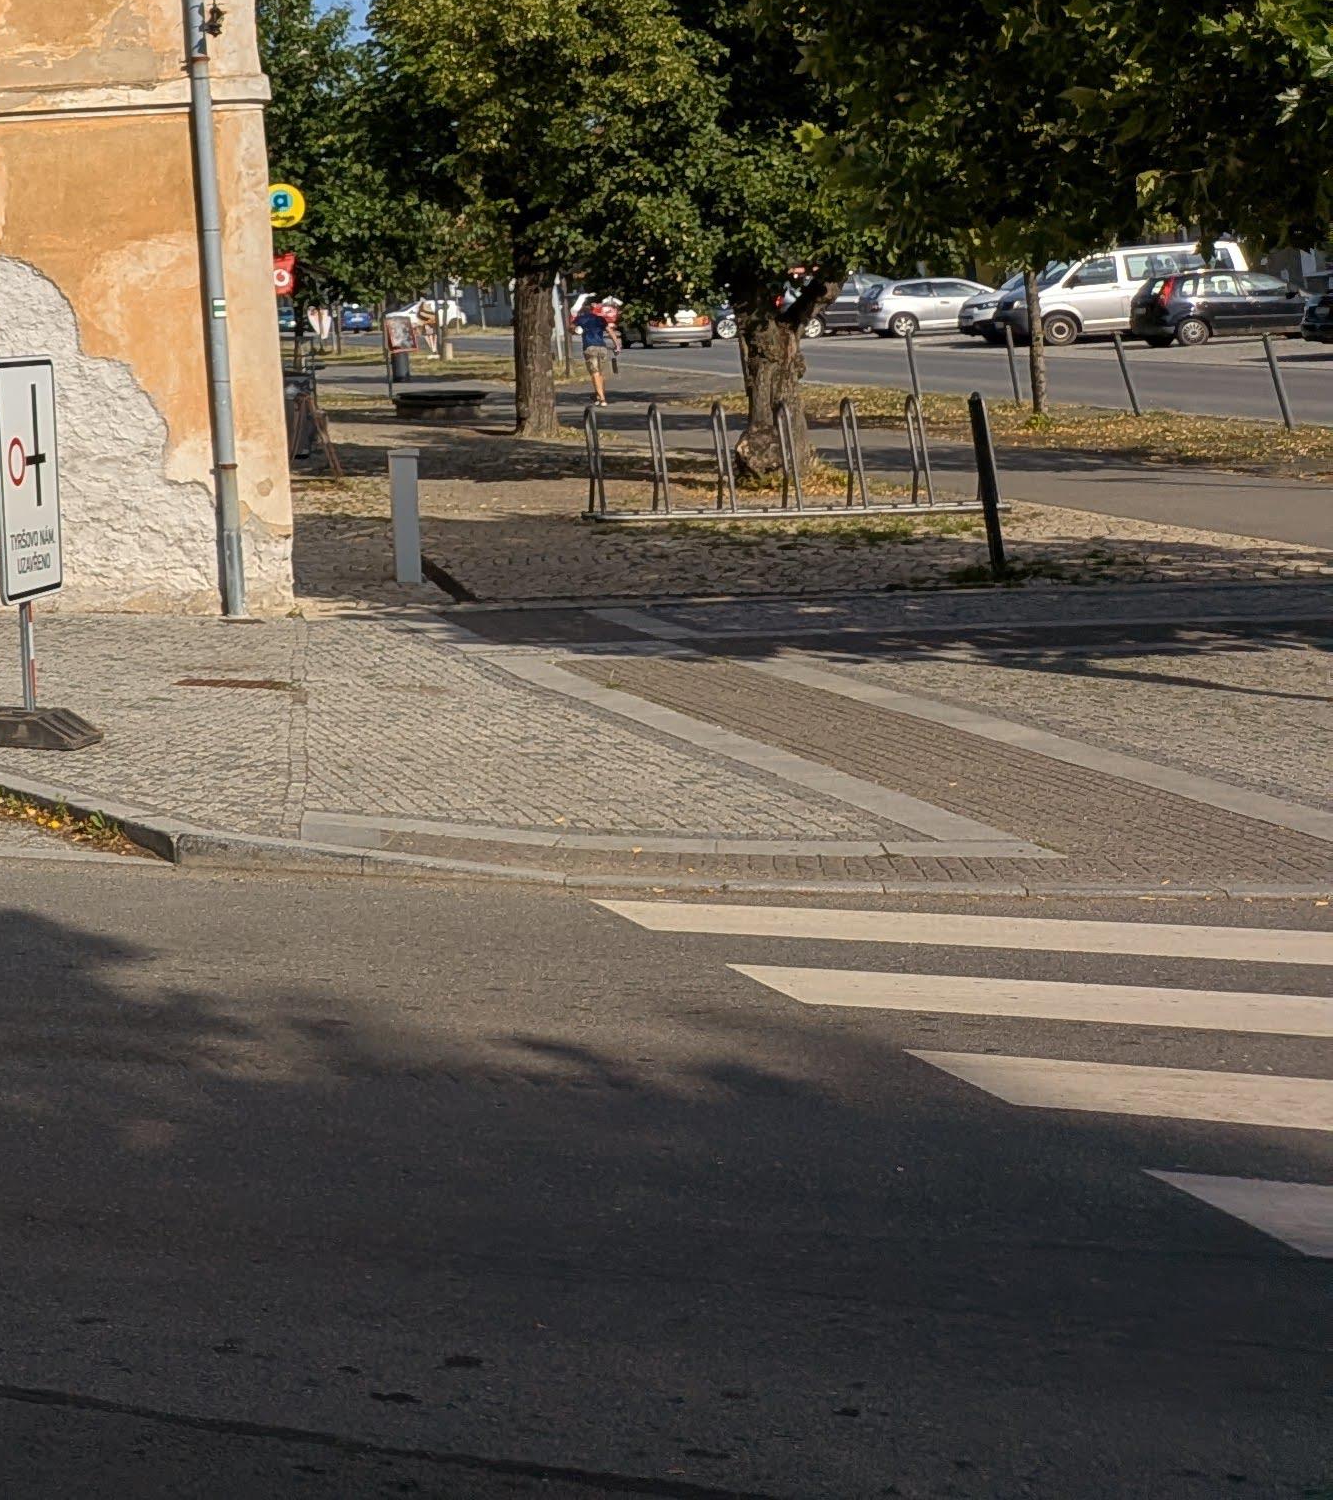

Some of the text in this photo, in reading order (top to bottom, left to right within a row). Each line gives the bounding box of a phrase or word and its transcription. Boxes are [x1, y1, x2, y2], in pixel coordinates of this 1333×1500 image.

[10, 525, 55, 550] TYRŠOVO NÁM.
[17, 551, 51, 574] UZAVŘENO
